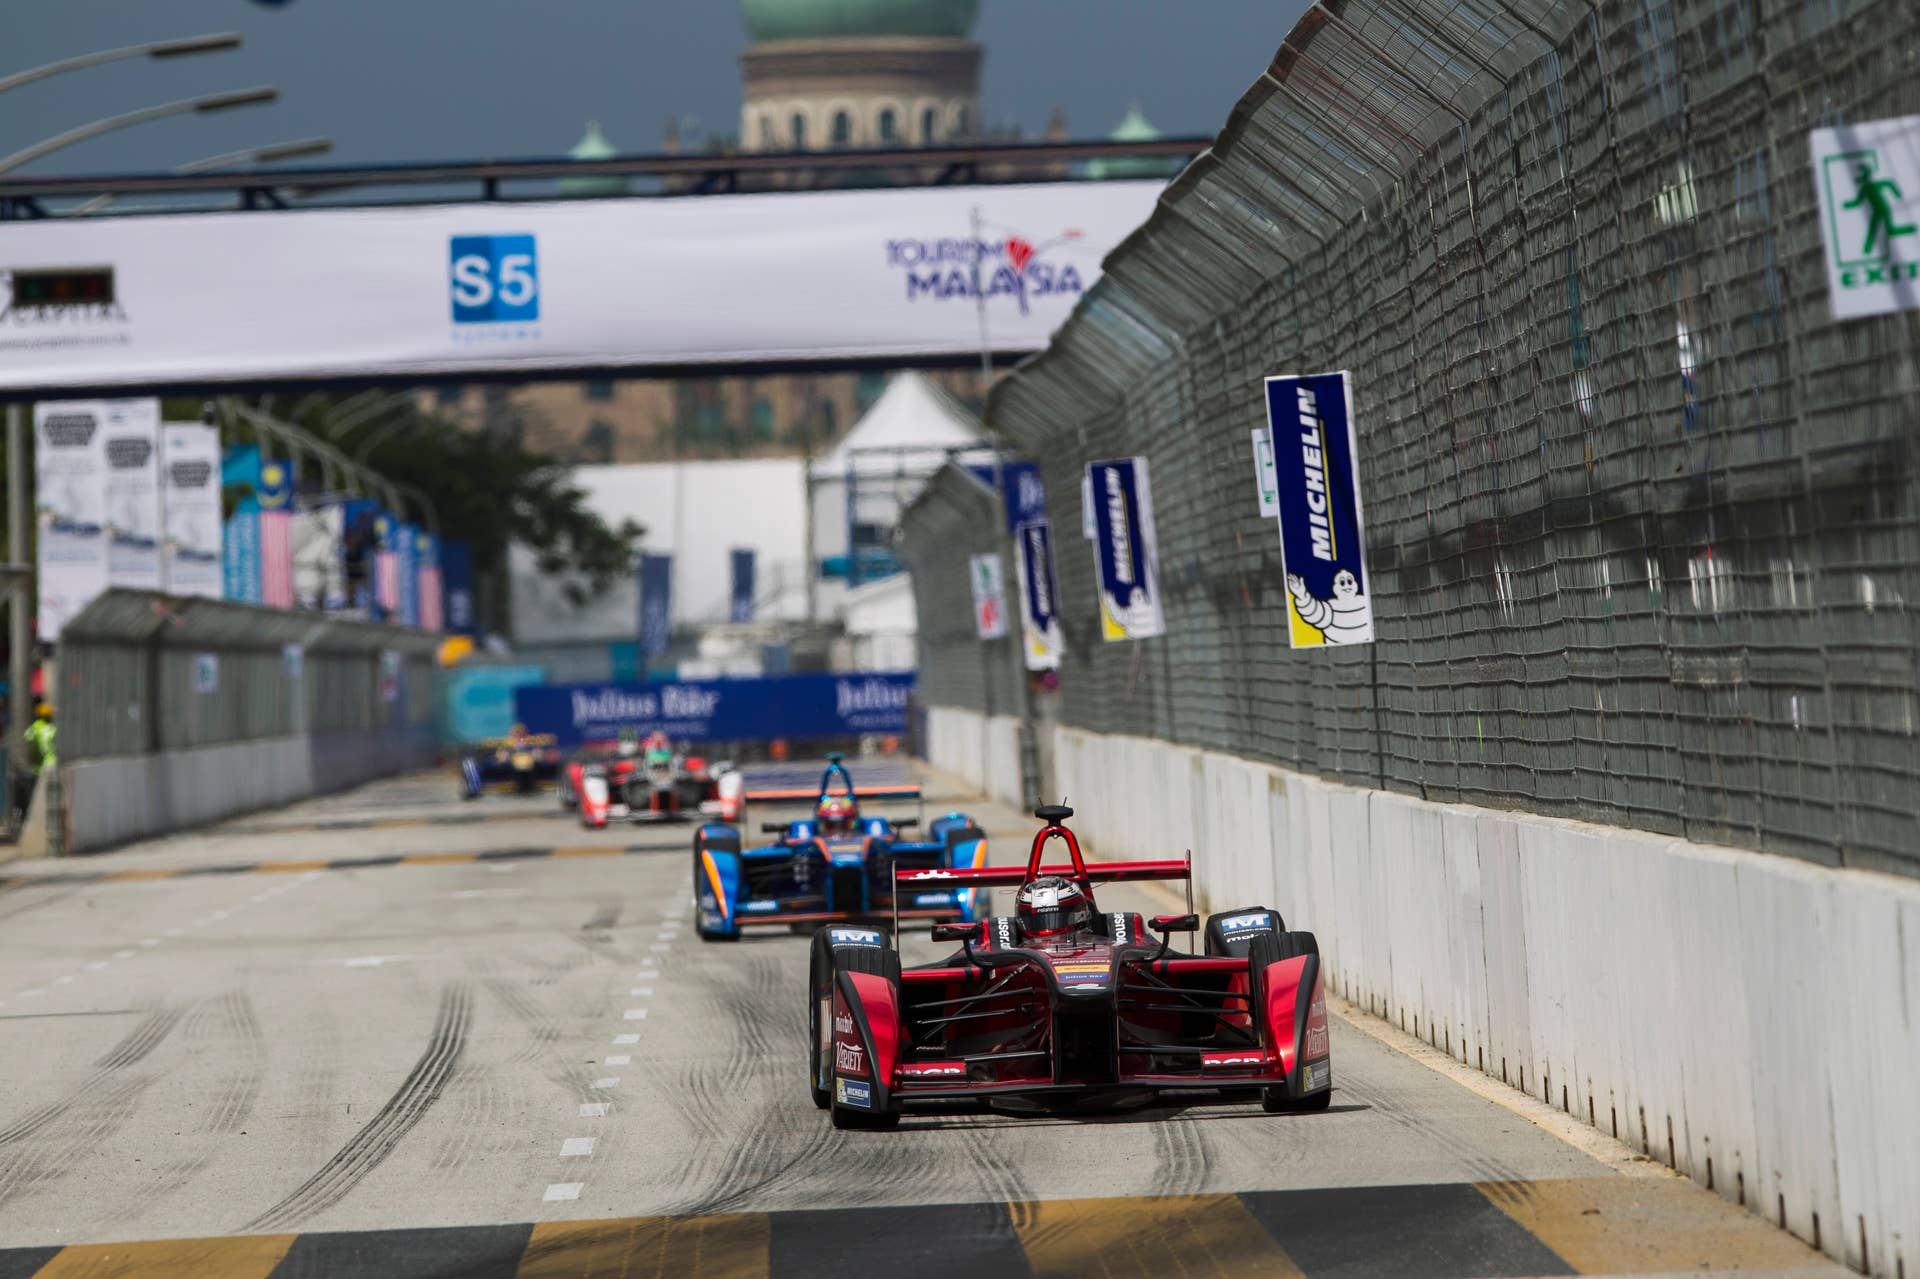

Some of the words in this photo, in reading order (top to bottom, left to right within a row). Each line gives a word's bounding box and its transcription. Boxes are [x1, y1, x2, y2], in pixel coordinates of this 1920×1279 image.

[455, 254, 534, 307] S5
[906, 262, 1082, 316] MALAYSIA
[1296, 386, 1334, 562] MICHELIN
